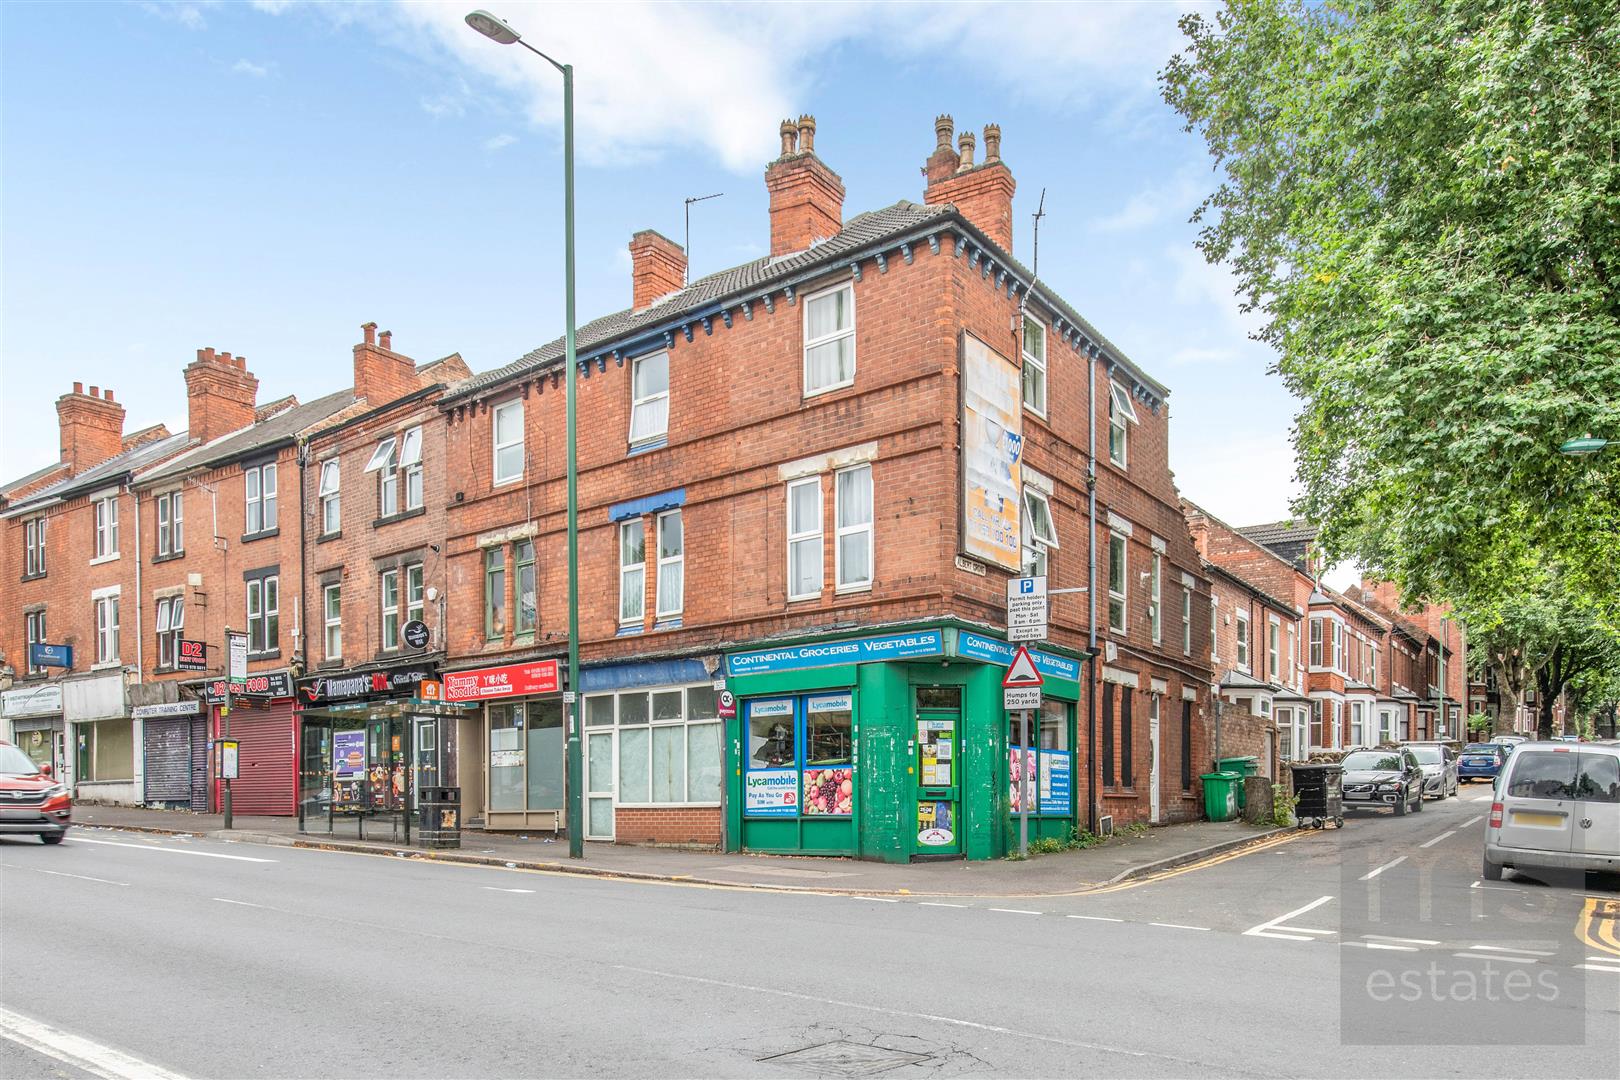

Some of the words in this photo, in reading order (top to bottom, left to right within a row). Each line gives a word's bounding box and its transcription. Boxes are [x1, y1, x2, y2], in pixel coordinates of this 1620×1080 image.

[957, 557, 972, 569] ALBERT
[1023, 580, 1032, 593] P
[181, 641, 203, 657] D2
[732, 651, 799, 666] CONTINENTAL
[799, 643, 859, 659] GROCERIES
[863, 635, 936, 652] VEGETABLES
[966, 636, 1010, 656] CONTINENTAL
[1042, 655, 1073, 672] VEGETABLES
[246, 676, 269, 693] FOOD
[326, 674, 369, 697] Mamapapa's
[447, 675, 479, 688] Yummy
[447, 686, 480, 699] Noodles
[135, 707, 157, 716] COMPUTER
[158, 705, 178, 713] TRAINING
[179, 703, 197, 711] CENTRE
[754, 704, 788, 715] Lycamobile
[812, 698, 848, 710] Lycamobile
[747, 775, 797, 788] Lycamobile
